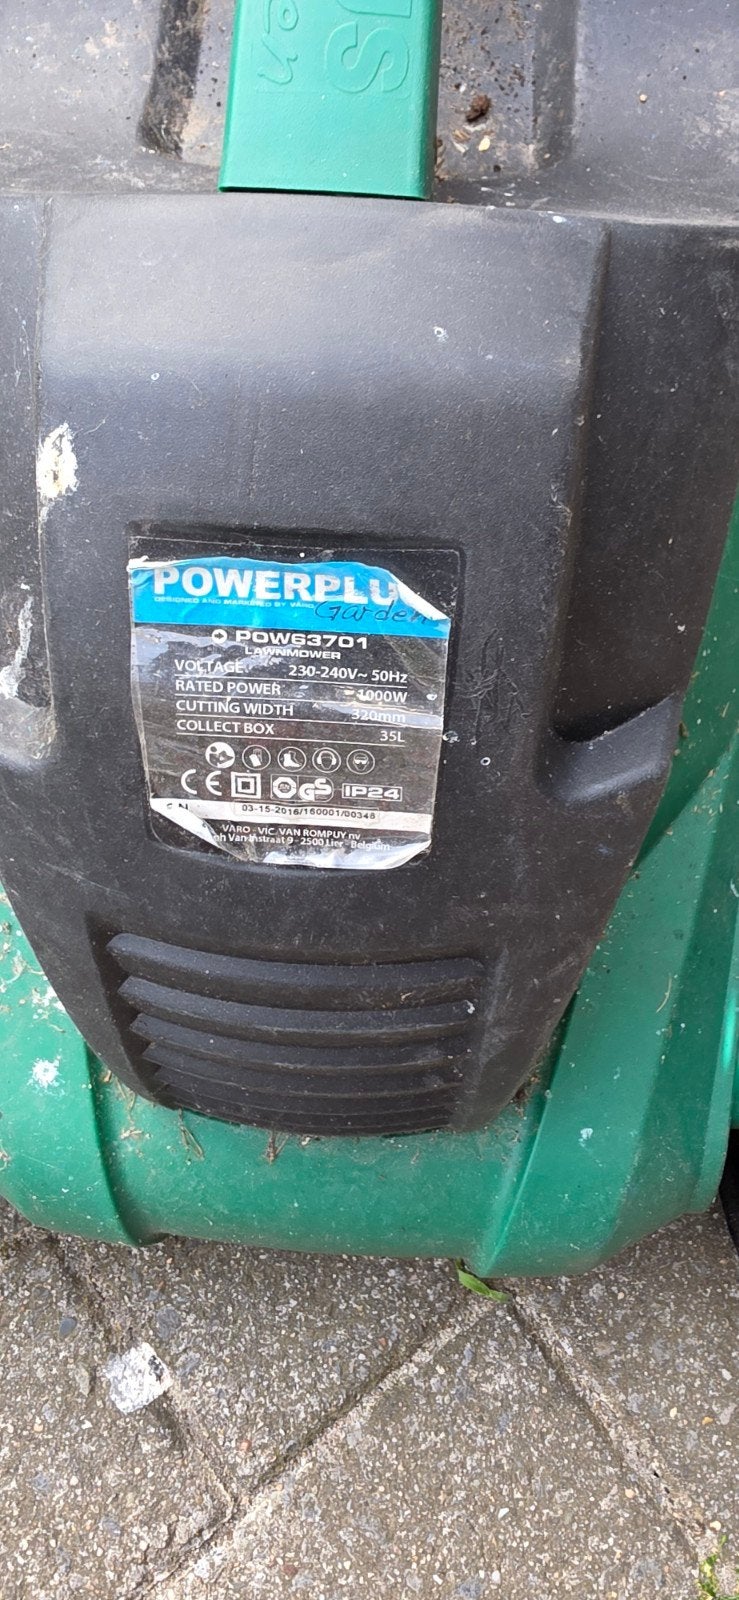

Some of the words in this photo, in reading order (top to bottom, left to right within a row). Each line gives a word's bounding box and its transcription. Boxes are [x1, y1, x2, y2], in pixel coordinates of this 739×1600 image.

[153, 566, 398, 605] POWERPLU
[235, 630, 368, 650] POW63701
[244, 647, 341, 660] LAWNMOWER
[371, 670, 408, 684] 50Hz
[175, 680, 224, 694] RATED
[227, 682, 281, 696] POWER
[356, 688, 408, 704] 1000W
[176, 700, 241, 714] CUTTING
[244, 702, 294, 717] WIDTH
[351, 709, 406, 724] 320mm
[176, 719, 243, 734] COLLECT
[244, 721, 275, 736] BOX
[379, 731, 405, 743] 35L
[344, 785, 401, 800] IP24
[222, 824, 251, 834] VARO
[278, 828, 301, 837] VAN
[302, 829, 347, 840] ROMPUY
[348, 833, 361, 841] nv
[300, 837, 324, 847] 2500
